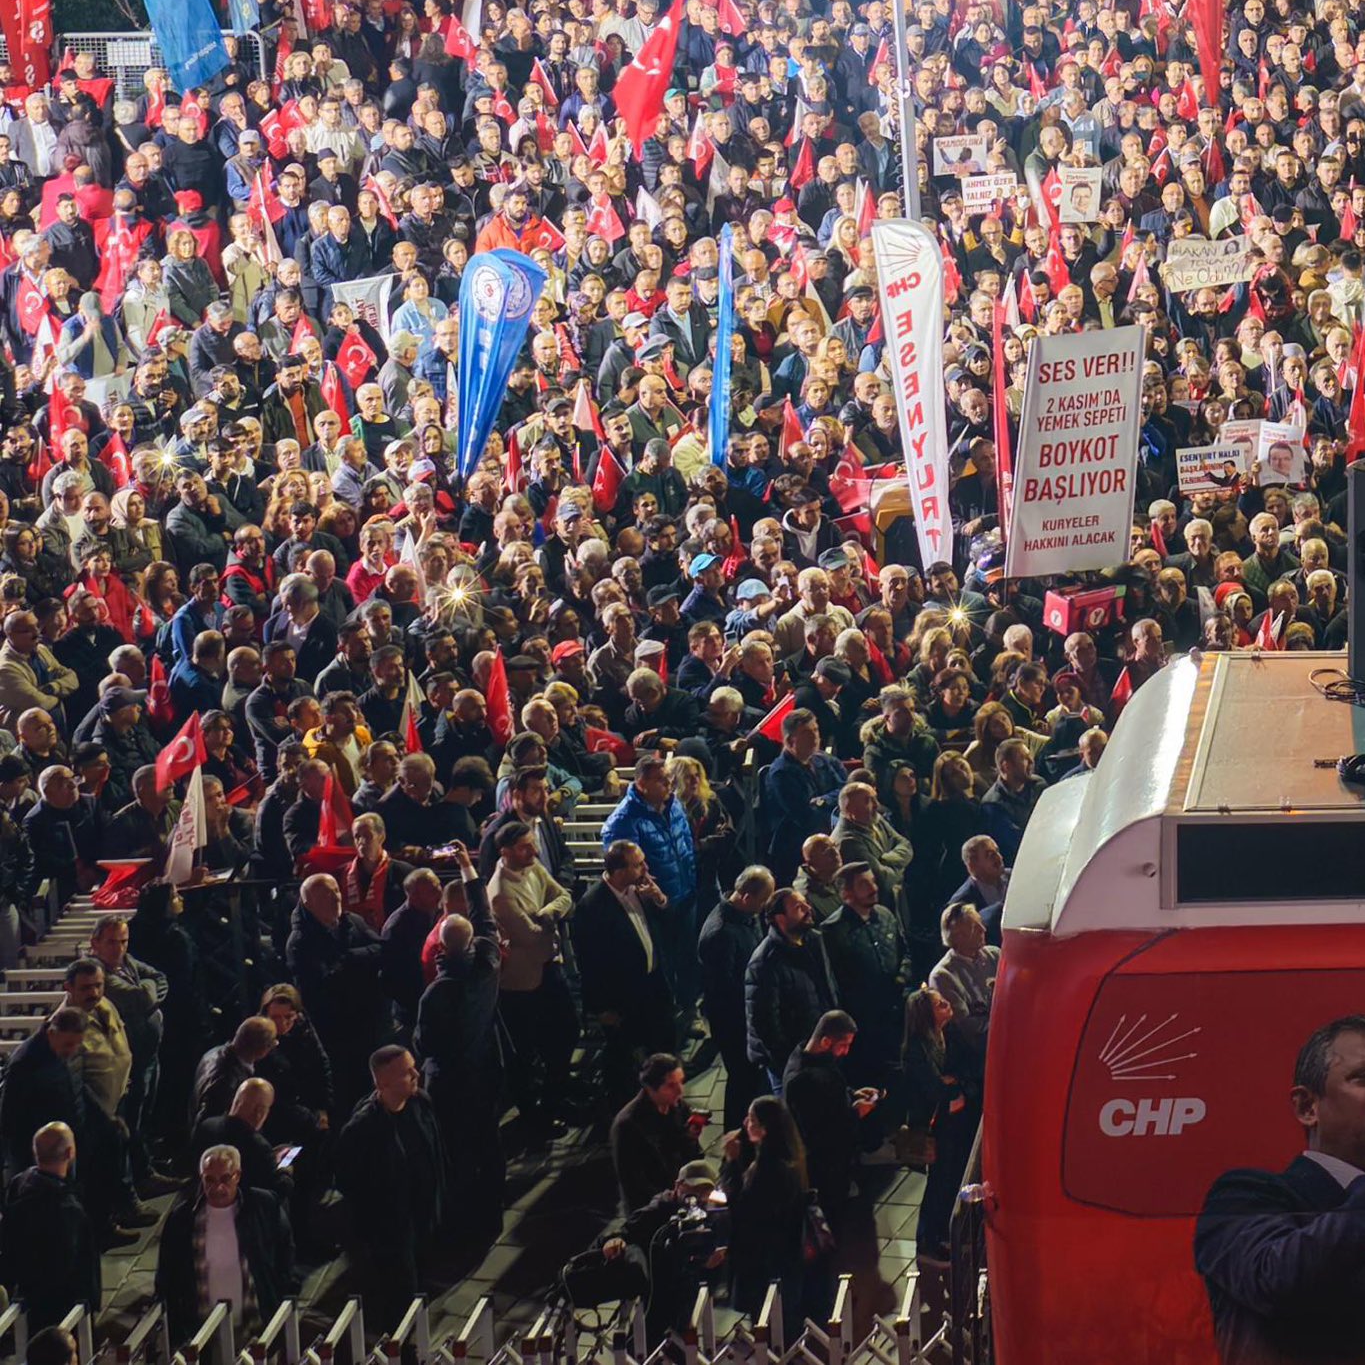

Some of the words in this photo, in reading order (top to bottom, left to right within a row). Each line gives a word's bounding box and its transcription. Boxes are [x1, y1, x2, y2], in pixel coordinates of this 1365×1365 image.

[1038, 359, 1075, 384] SES
[1083, 351, 1135, 376] VER!!
[1046, 398, 1055, 413] 2
[1058, 389, 1121, 412] KASIM'DA
[1037, 411, 1080, 432] YEMEK
[1083, 405, 1126, 427] SEPETİ
[1039, 434, 1119, 468] BOYKOT
[1024, 468, 1126, 505] BAŞLIYOR
[1042, 515, 1099, 531] KURYELER
[1024, 537, 1068, 552] HAKKINI
[1072, 531, 1115, 546] ALACAK
[1099, 1097, 1206, 1137] CHP
